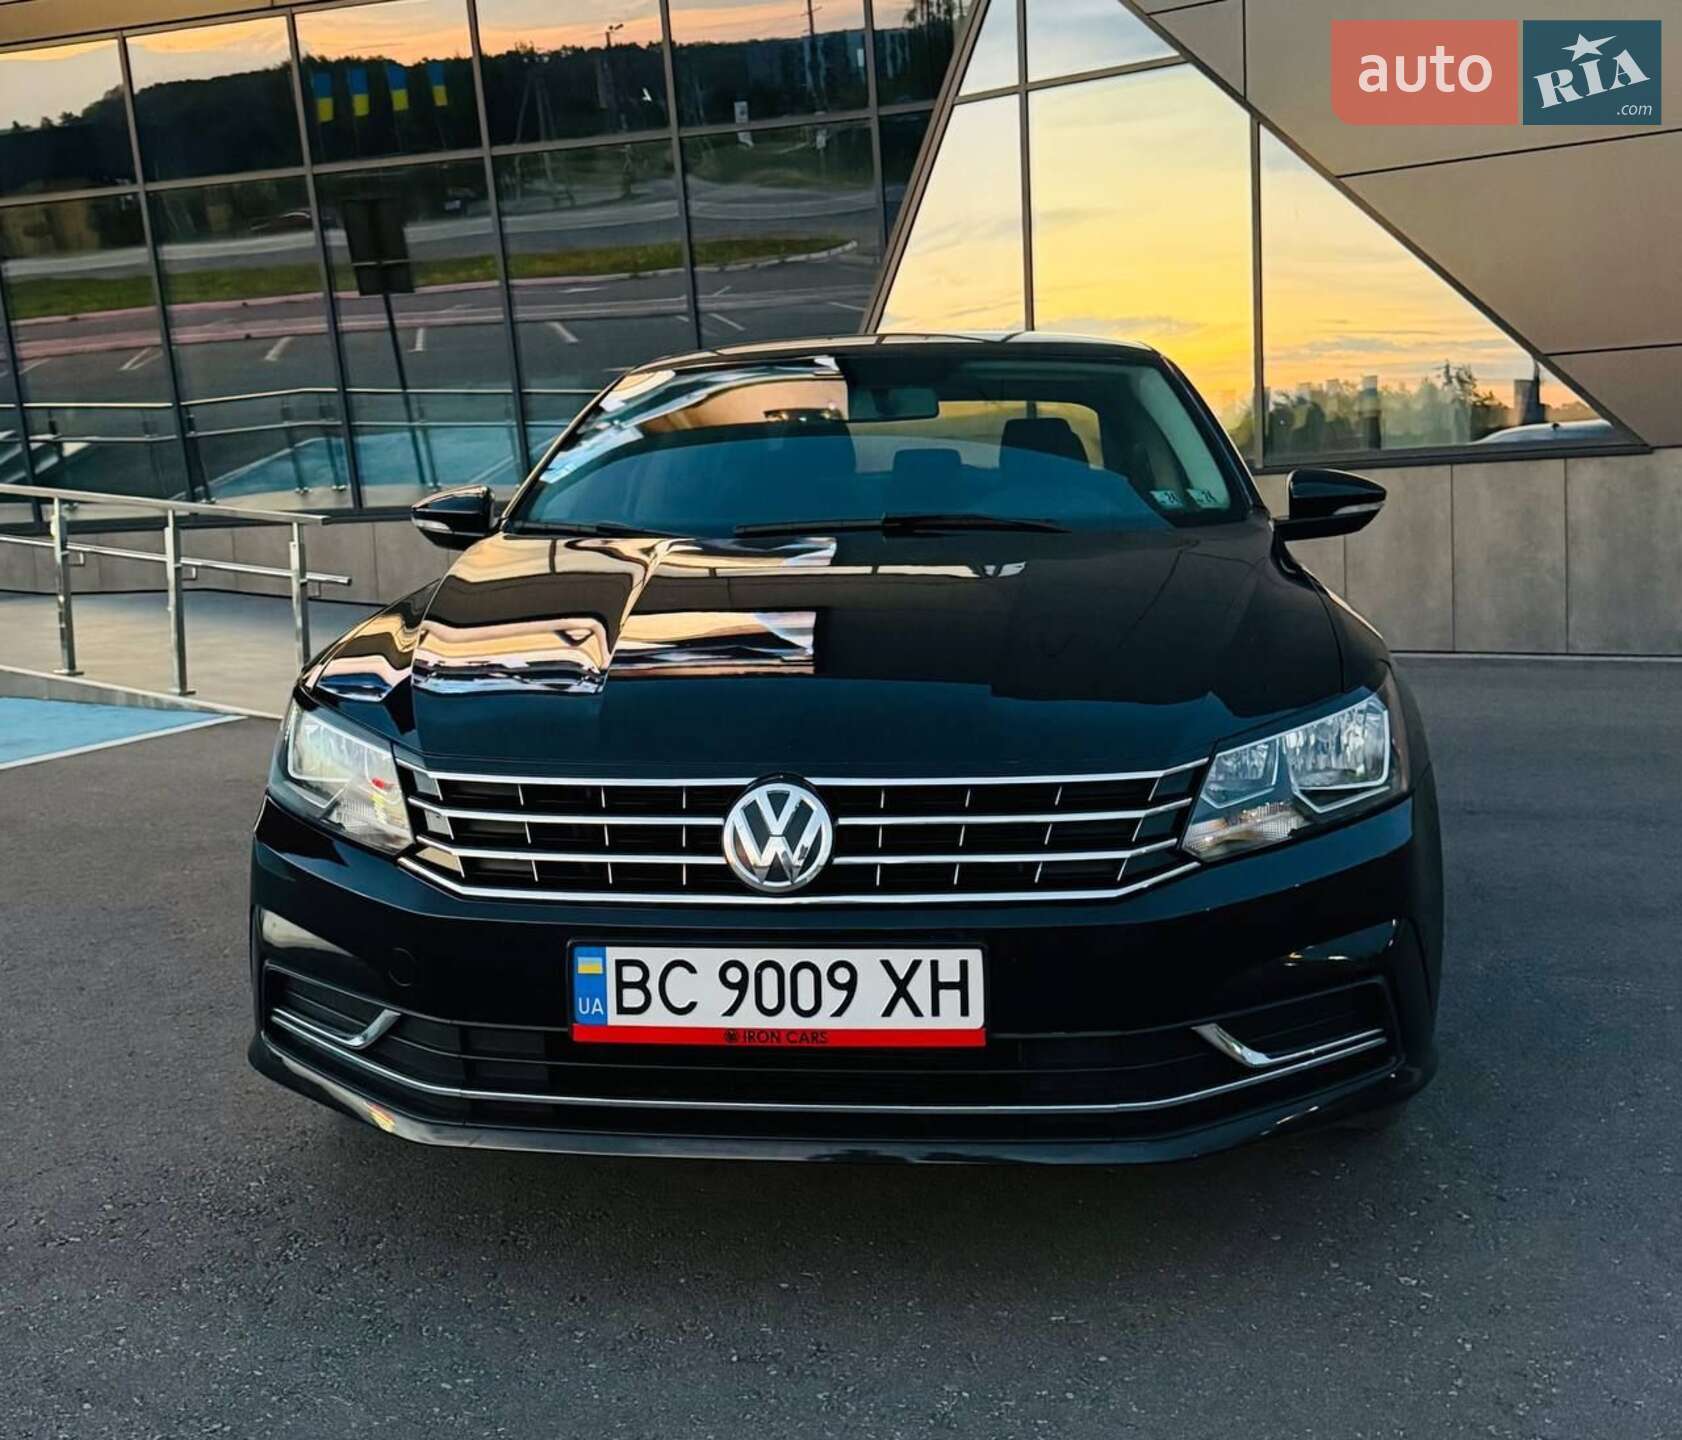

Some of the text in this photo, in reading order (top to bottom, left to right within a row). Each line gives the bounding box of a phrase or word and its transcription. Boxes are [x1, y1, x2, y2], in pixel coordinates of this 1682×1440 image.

[614, 958, 971, 1018] BC 9009 XH
[578, 997, 605, 1016] UA
[743, 1029, 829, 1045] IRON CARS
